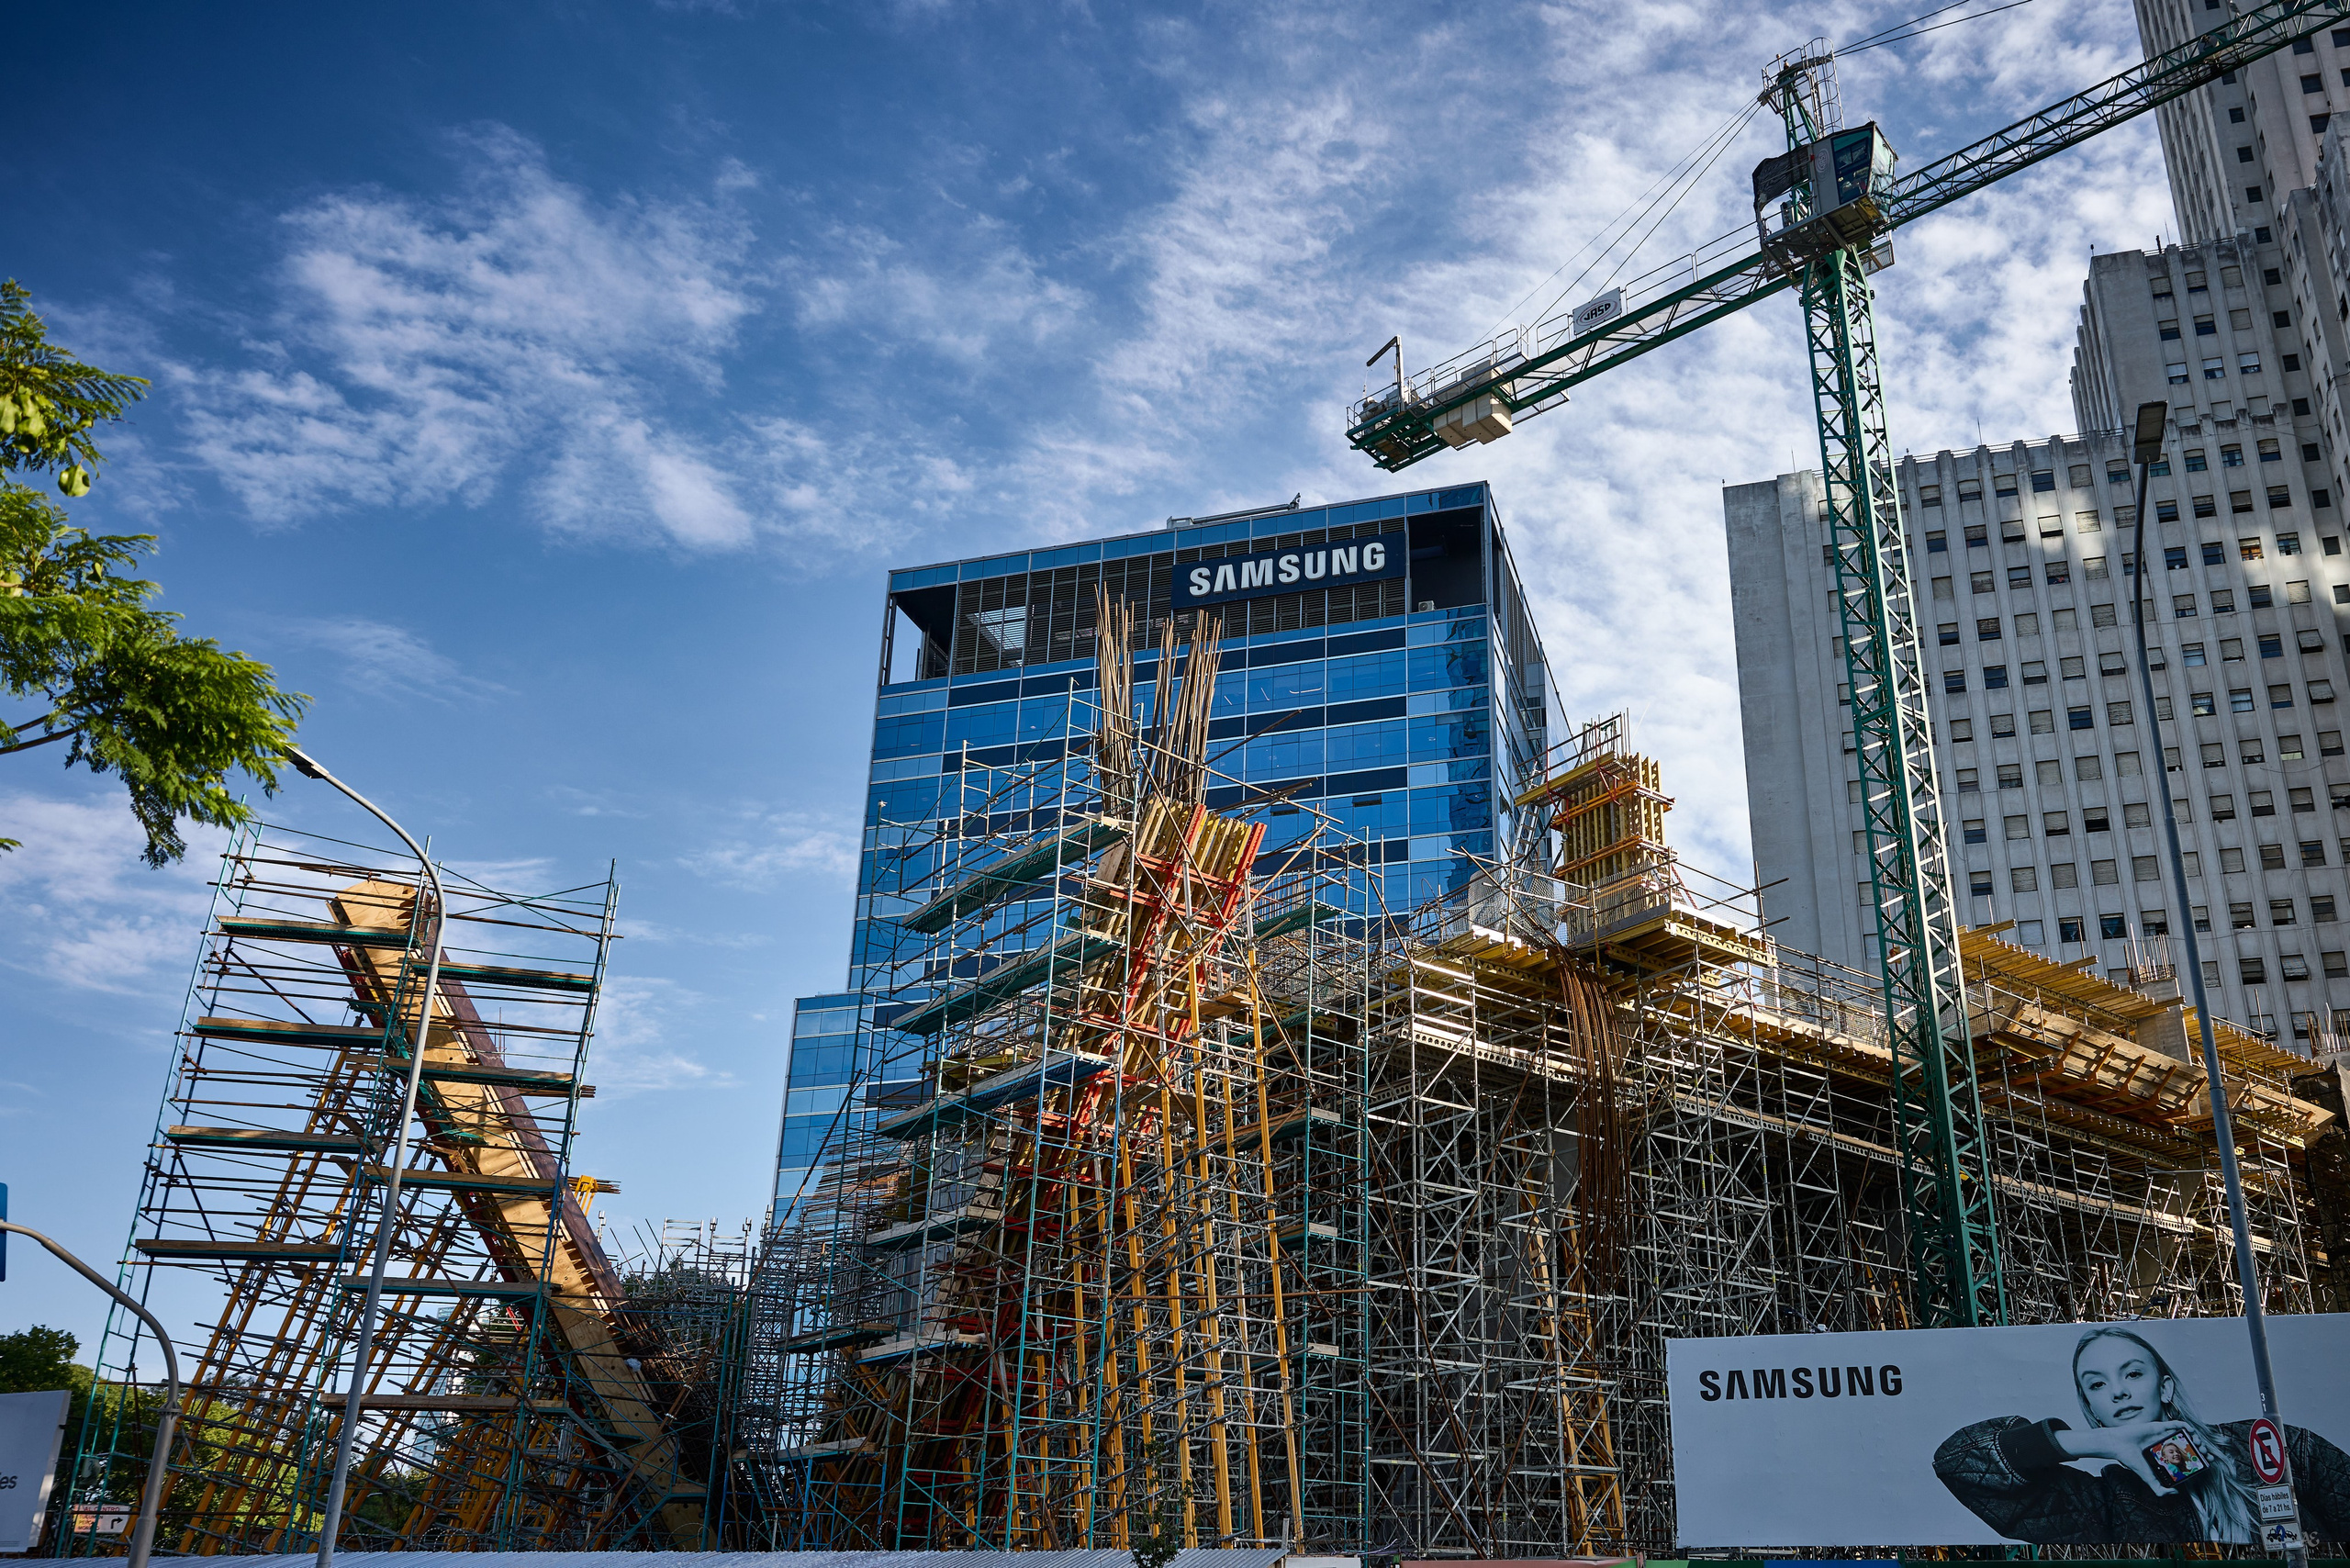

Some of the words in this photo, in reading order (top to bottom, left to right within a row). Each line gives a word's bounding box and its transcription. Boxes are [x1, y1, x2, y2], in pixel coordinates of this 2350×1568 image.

[1583, 303, 1611, 320] JASP
[1189, 542, 1385, 597] SAMSUNG
[1699, 1364, 1903, 1401] SAMSUNG
[0, 1473, 18, 1489] es
[2260, 1494, 2271, 1502] Días
[2271, 1492, 2289, 1500] hábiles
[2262, 1505, 2269, 1513] de
